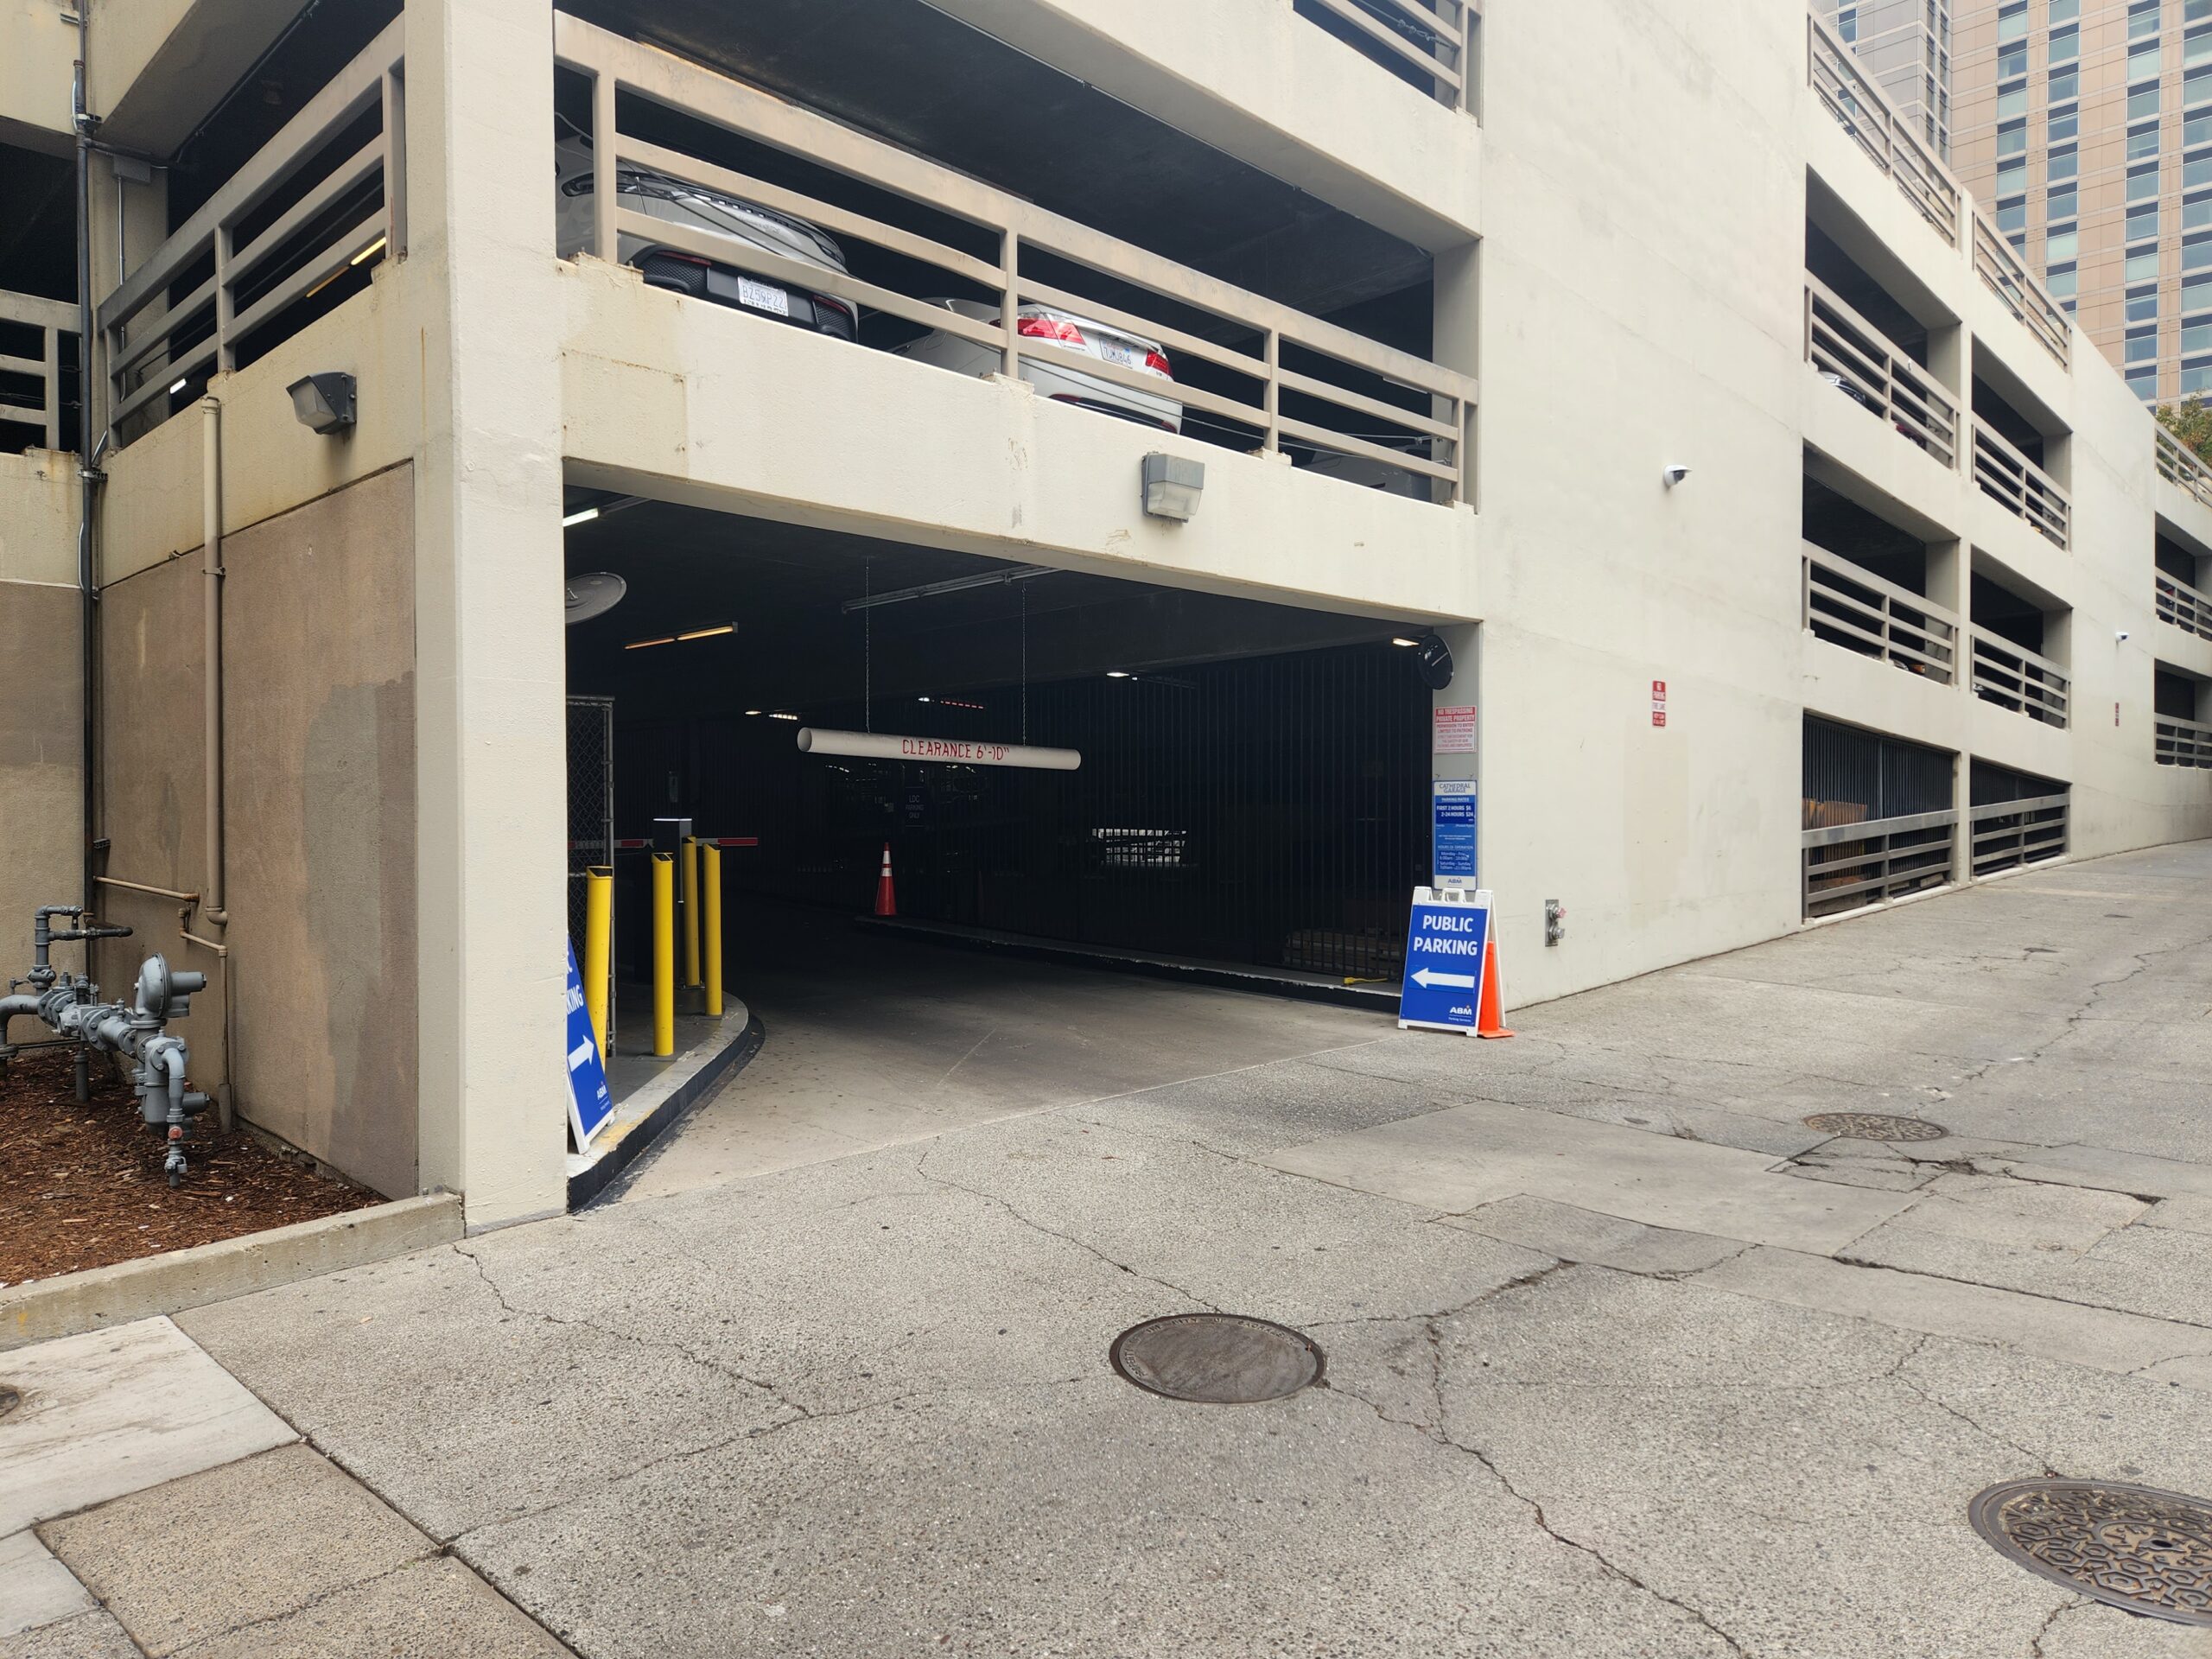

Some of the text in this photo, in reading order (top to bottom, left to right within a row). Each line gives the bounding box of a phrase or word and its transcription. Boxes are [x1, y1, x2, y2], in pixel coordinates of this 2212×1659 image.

[902, 739, 972, 759] CLEARANCE
[1423, 914, 1474, 932] PUBLIC
[1414, 937, 1478, 956] PARKING
[1449, 1007, 1472, 1015] ABM
